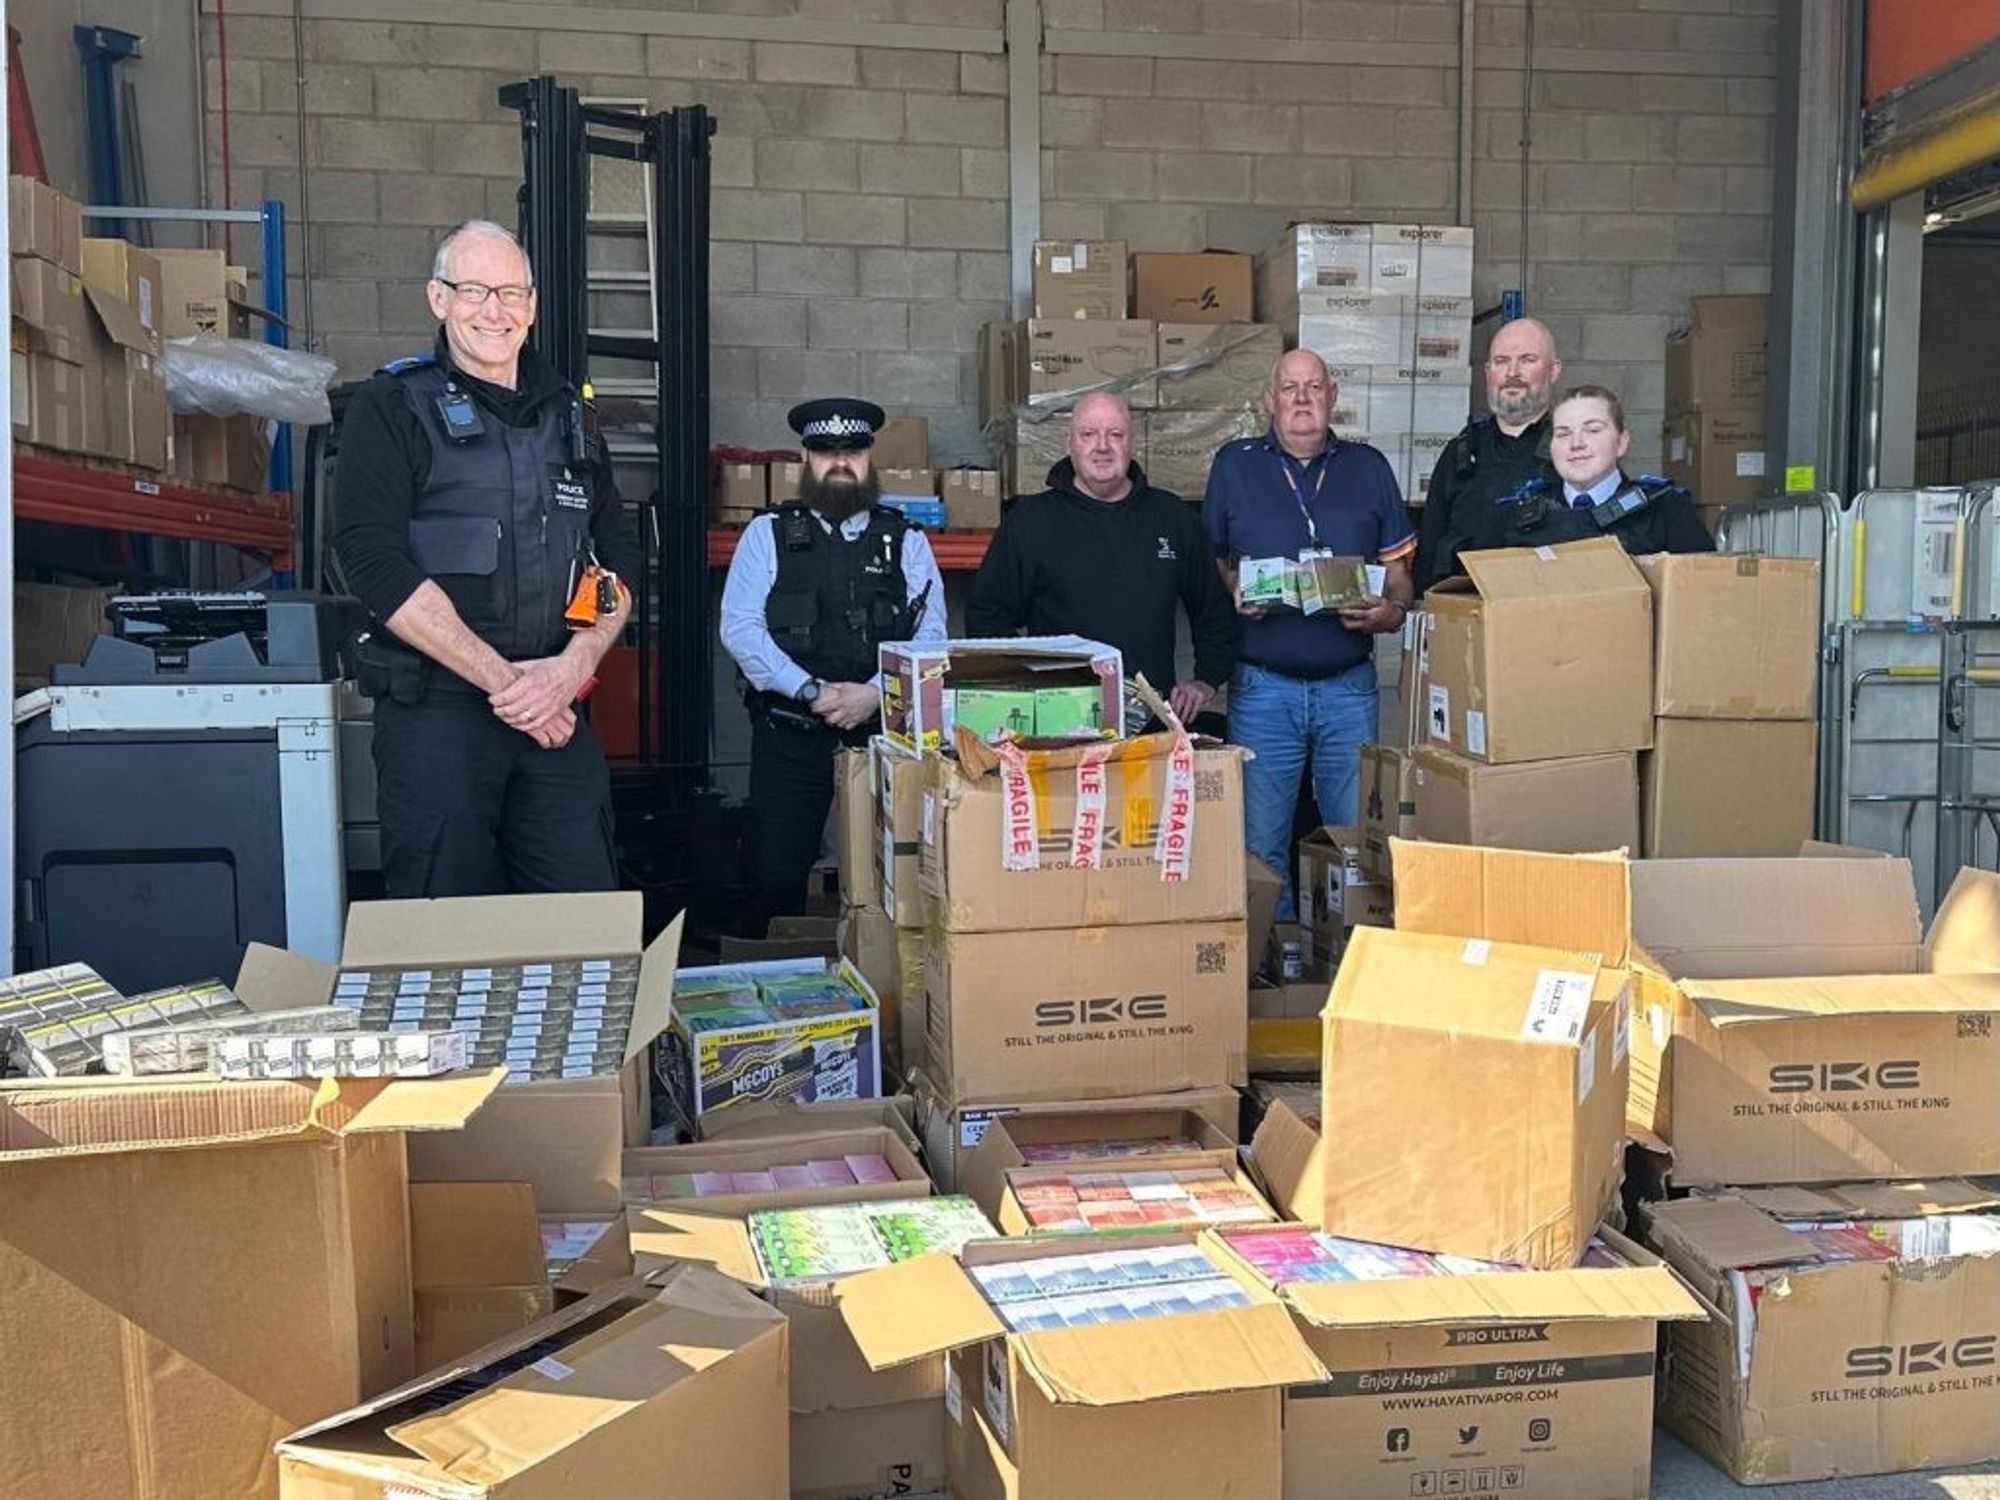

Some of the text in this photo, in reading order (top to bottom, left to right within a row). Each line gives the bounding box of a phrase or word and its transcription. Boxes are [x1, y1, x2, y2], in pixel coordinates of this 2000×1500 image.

[1035, 994, 1167, 1026] SKE
[1004, 1024, 1195, 1048] STILL THE ORIGINAL & STILL THE KING
[1768, 1060, 1921, 1093] SKE
[1732, 1096, 1950, 1116] STILL THE ORIGINAL & STILL THE KING
[1456, 1327, 1538, 1344] PRO ULTRA
[1844, 1335, 1997, 1379] SKE
[1359, 1373, 1399, 1391] Enjoy
[1495, 1362, 1565, 1382] Enjoy Life
[1843, 1387, 1868, 1401] THE
[1869, 1383, 1925, 1399] ORIGINAL
[1927, 1384, 1937, 1395] &
[1938, 1379, 1969, 1391] STILL
[1971, 1375, 1993, 1389] THE
[1382, 1389, 1559, 1411] WWW.HAYATIVAPOR.COM
